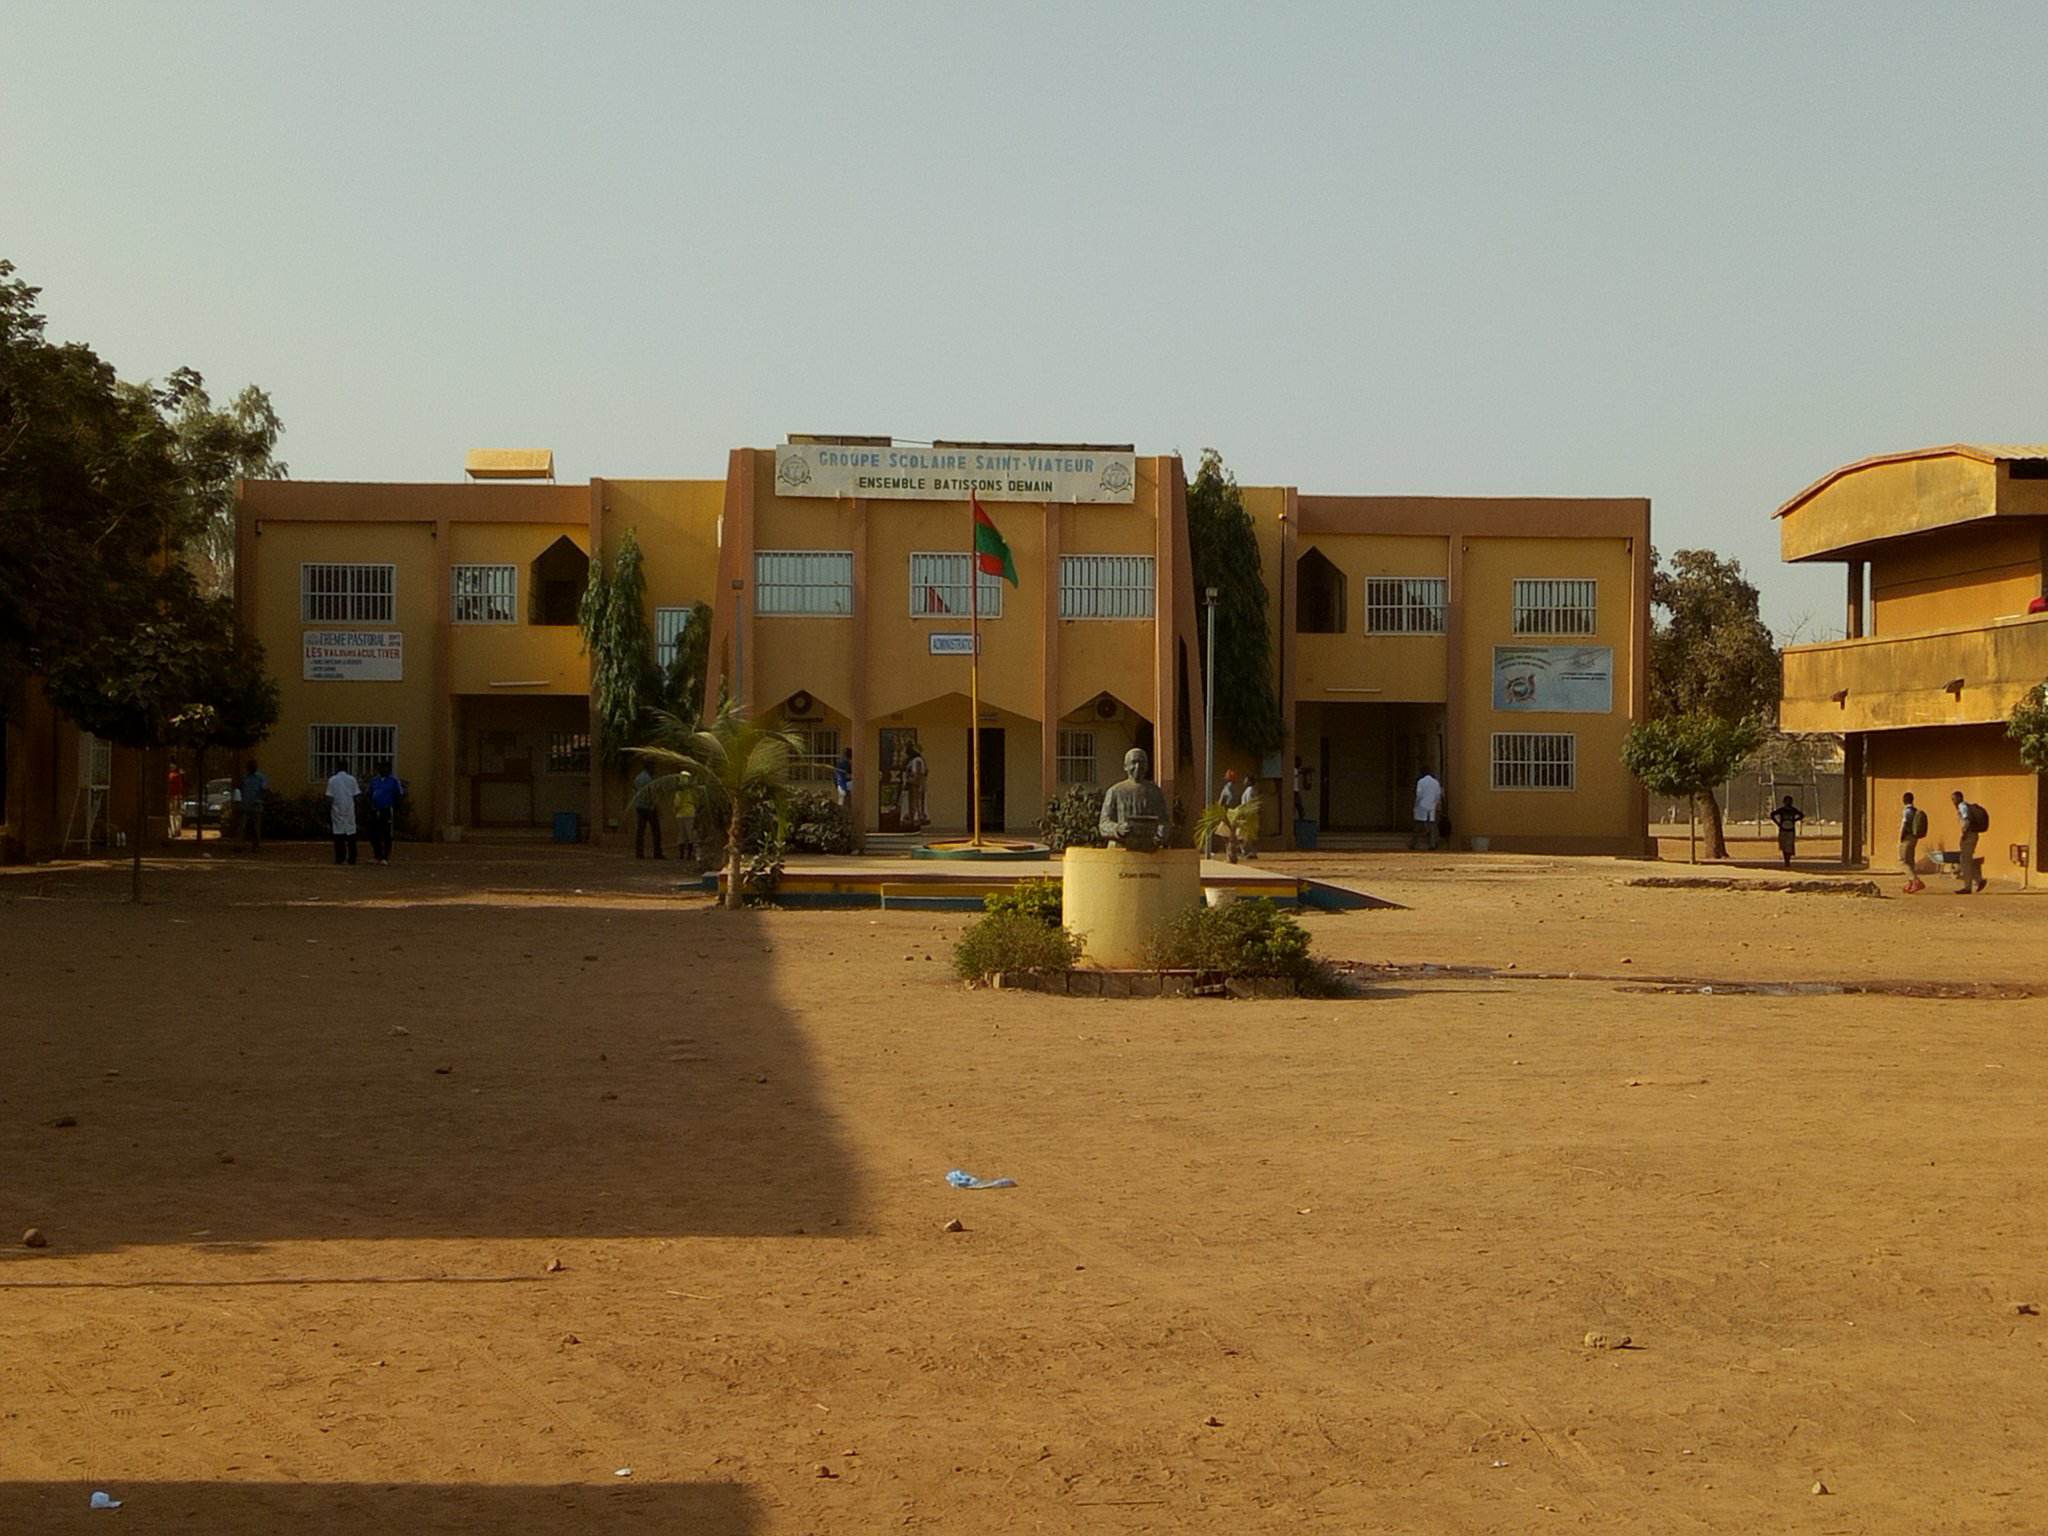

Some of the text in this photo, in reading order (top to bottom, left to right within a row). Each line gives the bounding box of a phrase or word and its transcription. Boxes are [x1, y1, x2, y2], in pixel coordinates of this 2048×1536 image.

[819, 451, 1094, 473] GROUPE SCOLAIRE SAINT-VIATEUR
[859, 477, 1053, 492] ENSEMBLE BATISSONS DEMAIN
[305, 647, 321, 658] LES
